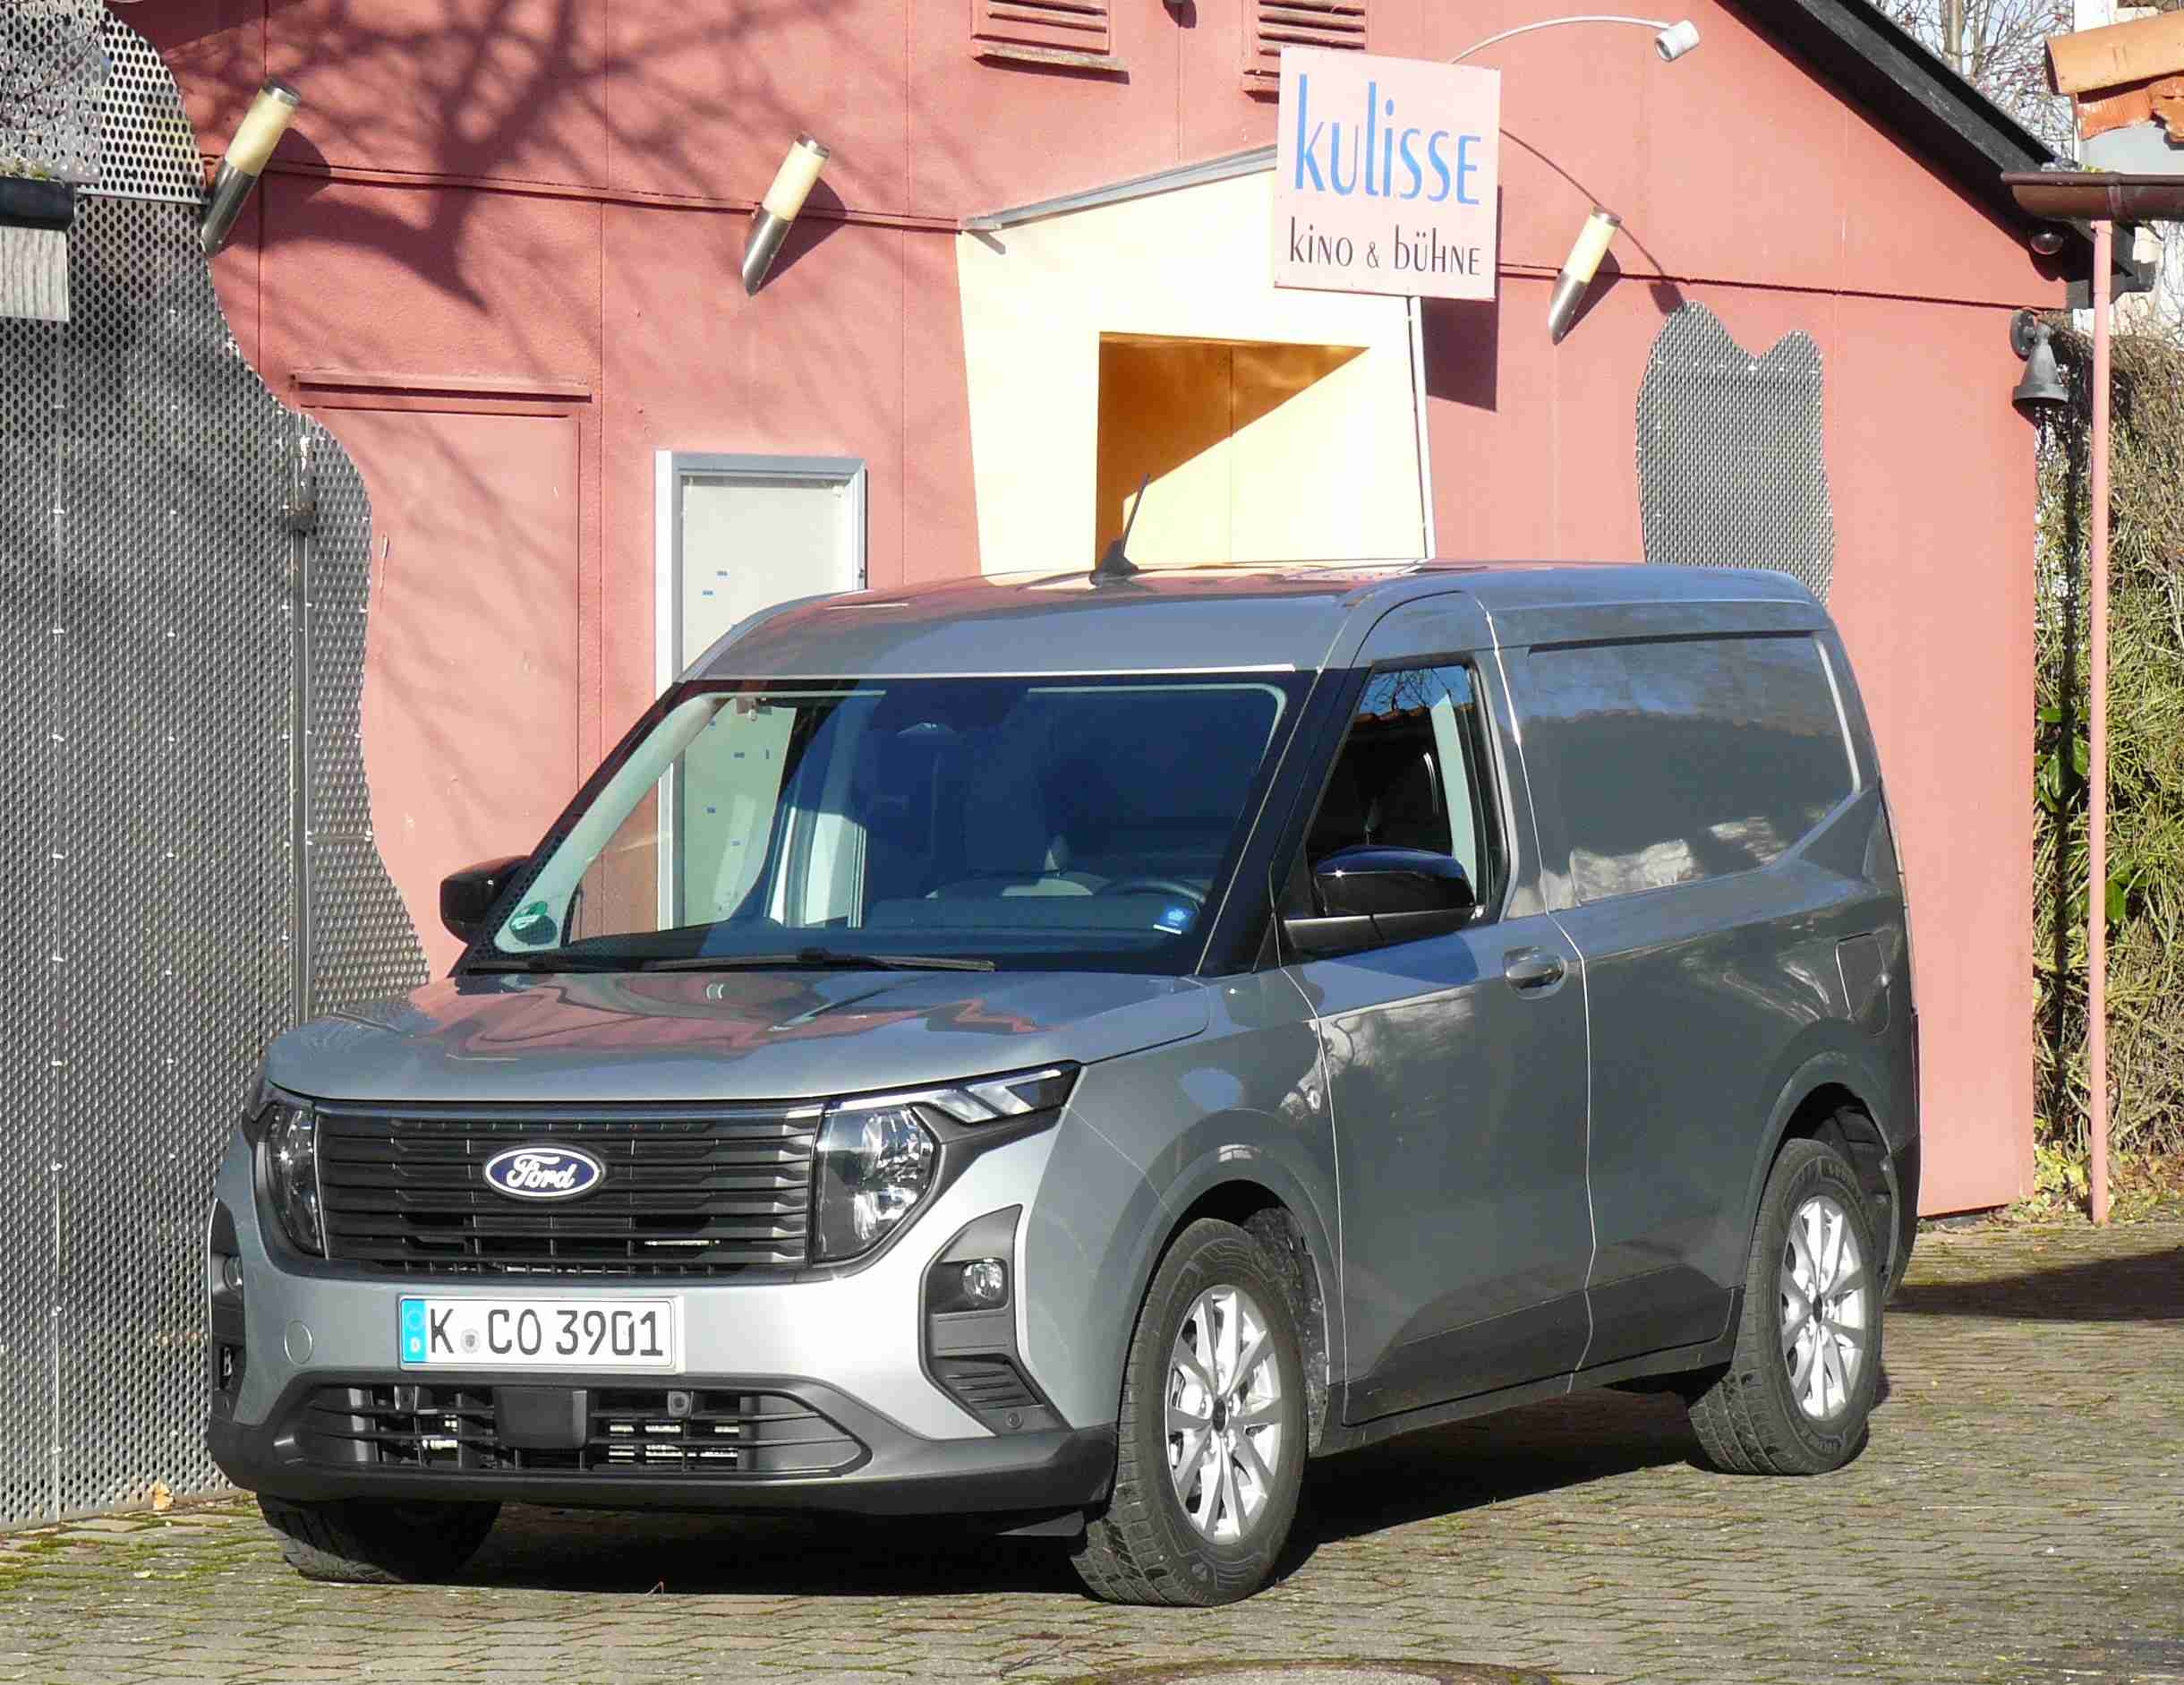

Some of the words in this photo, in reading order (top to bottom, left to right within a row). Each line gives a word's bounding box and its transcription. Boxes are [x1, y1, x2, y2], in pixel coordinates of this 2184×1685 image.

[1366, 241, 1380, 269] &
[506, 1153, 577, 1189] Ford
[430, 1308, 455, 1354] K
[488, 1308, 542, 1356] CO
[555, 1309, 663, 1356] 3901
